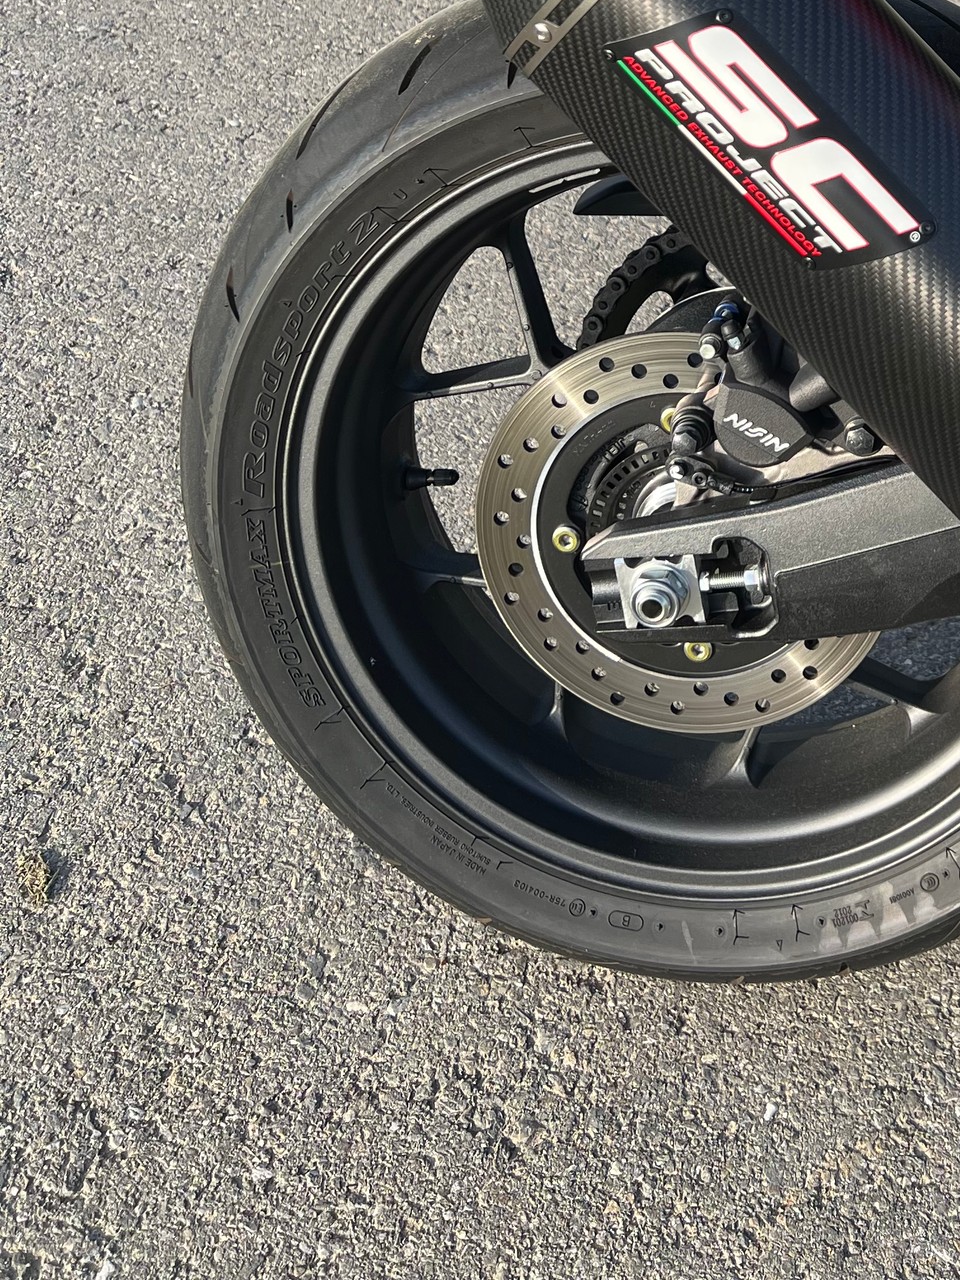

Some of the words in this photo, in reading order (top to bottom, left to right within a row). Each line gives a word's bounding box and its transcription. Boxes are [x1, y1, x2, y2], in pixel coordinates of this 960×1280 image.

[653, 25, 920, 251] SC
[622, 56, 689, 121] ADVANCED
[687, 122, 742, 177] EXHAUST
[741, 176, 822, 257] TECHNOLOGY
[634, 48, 843, 254] PROJECT
[242, 240, 352, 498] Roadsport
[245, 517, 327, 708] SPORTMAX
[386, 782, 400, 798] LTD.
[430, 834, 456, 856] JAPAN
[435, 824, 460, 846] RUBBER
[455, 852, 464, 861] IN
[460, 843, 491, 866] SUMITOMO
[465, 860, 487, 876] MADE
